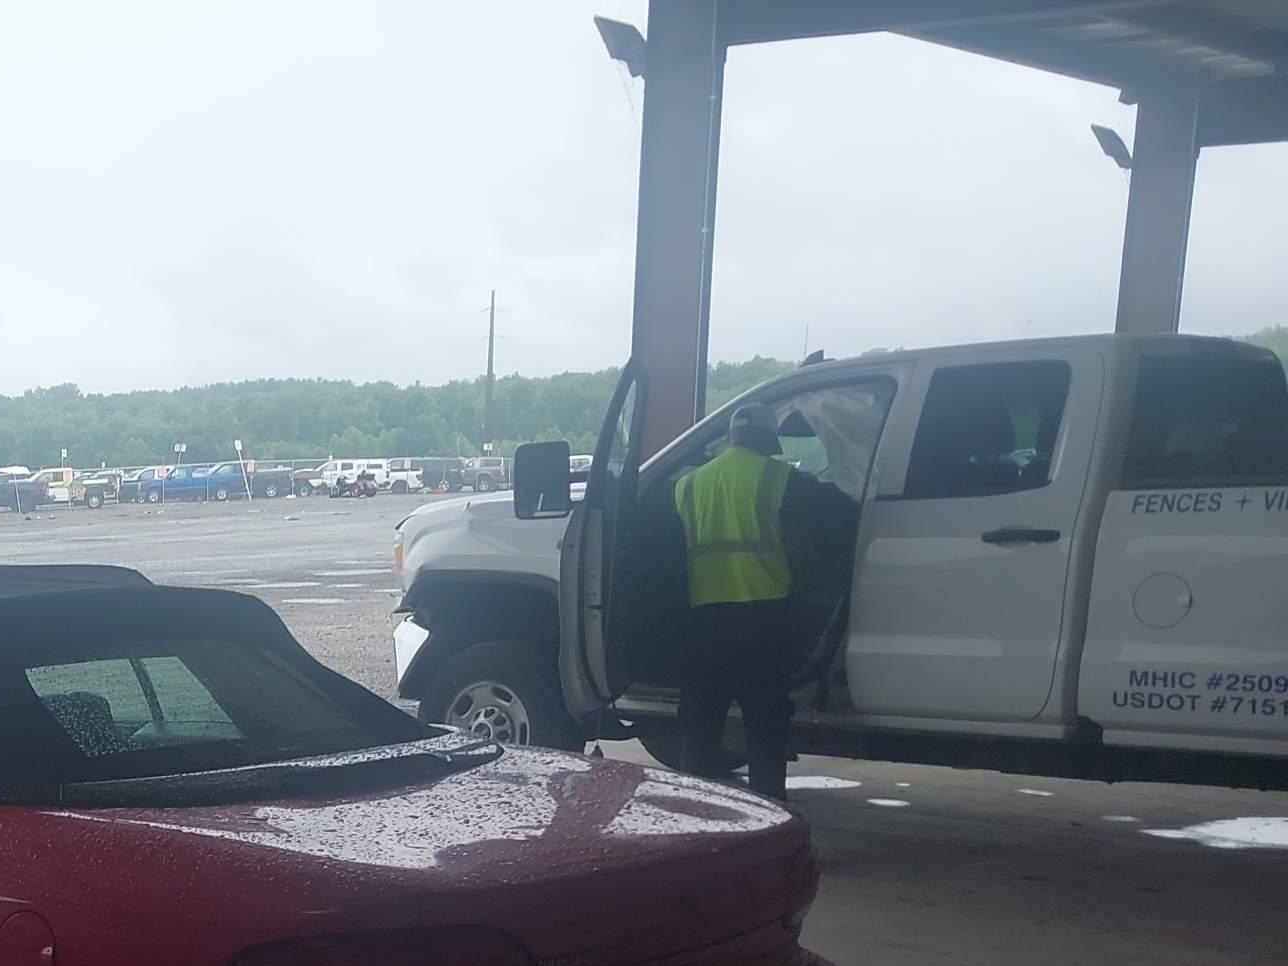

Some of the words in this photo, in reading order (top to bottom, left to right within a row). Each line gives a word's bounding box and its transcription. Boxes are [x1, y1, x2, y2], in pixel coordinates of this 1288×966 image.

[1131, 492, 1223, 514] FENCES
[1235, 492, 1253, 512] +
[1264, 490, 1288, 511] VI
[1129, 670, 1196, 689] MHIC
[1206, 673, 1288, 694] #2509
[1113, 691, 1201, 711] USDOT
